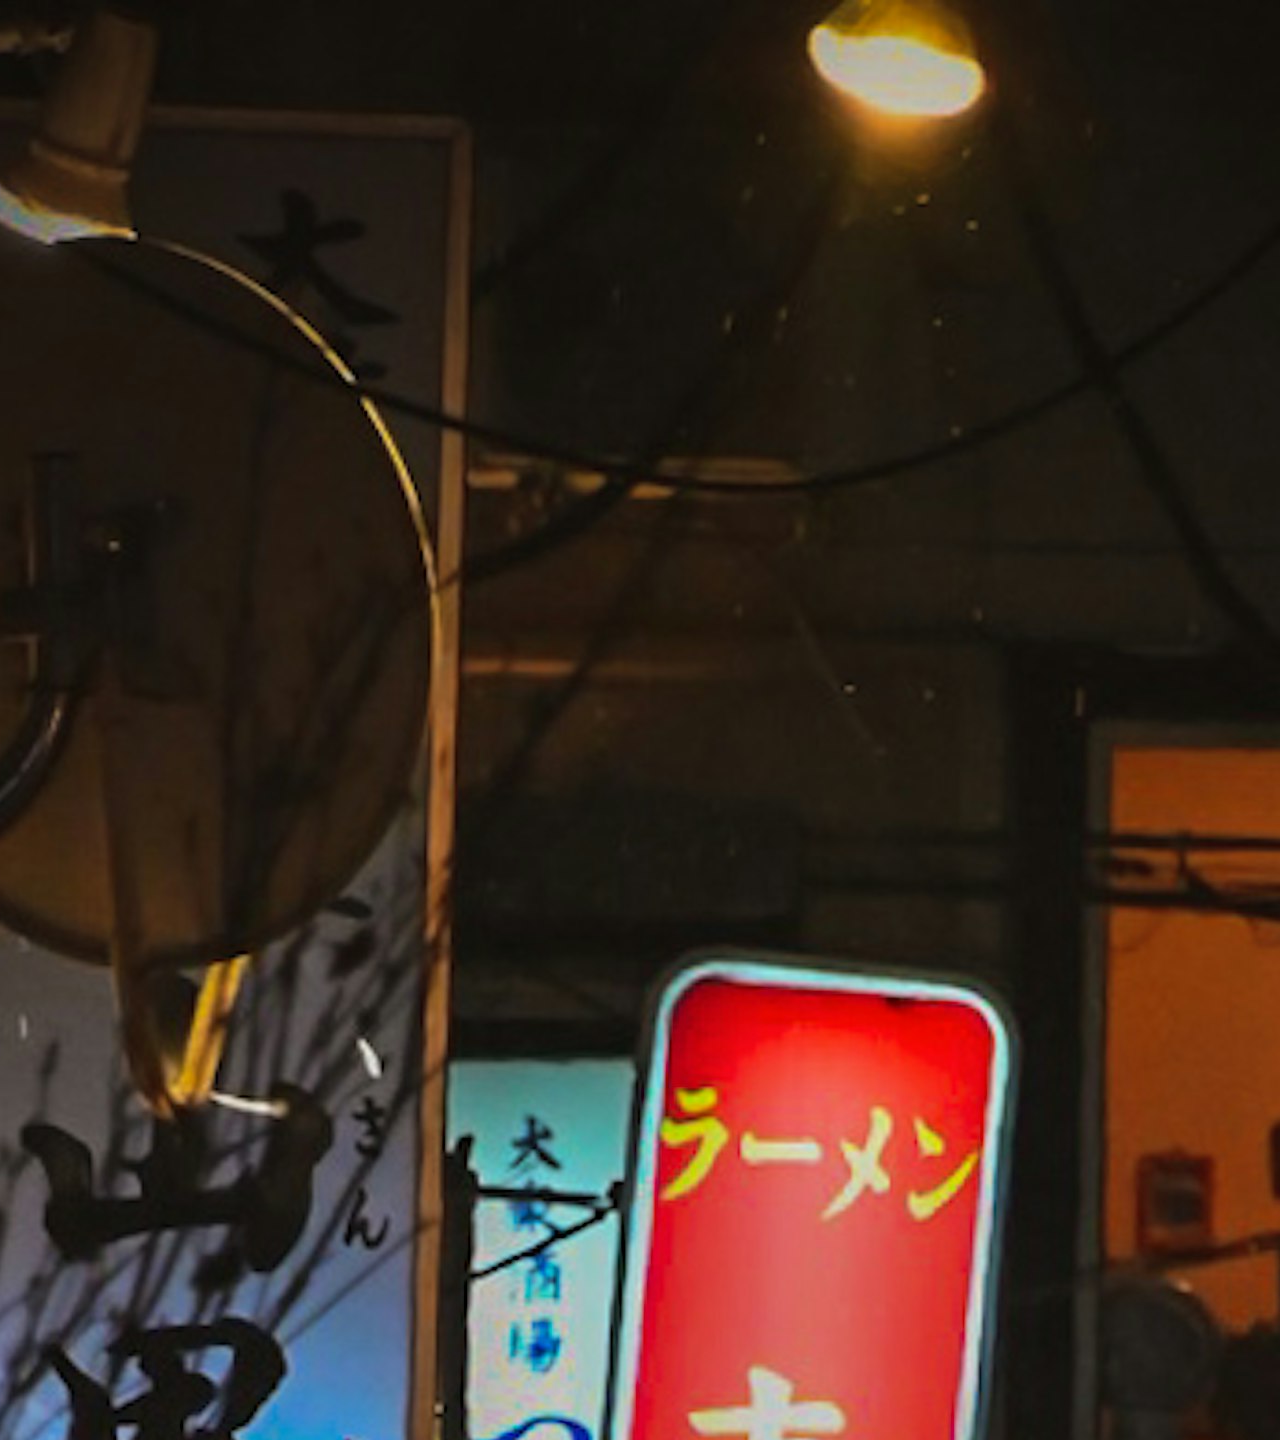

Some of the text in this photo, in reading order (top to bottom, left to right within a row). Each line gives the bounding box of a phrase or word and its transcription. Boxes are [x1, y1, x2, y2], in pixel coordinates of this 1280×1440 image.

[344, 1098, 389, 1248] さん
[660, 1086, 978, 1221] ラーメン
